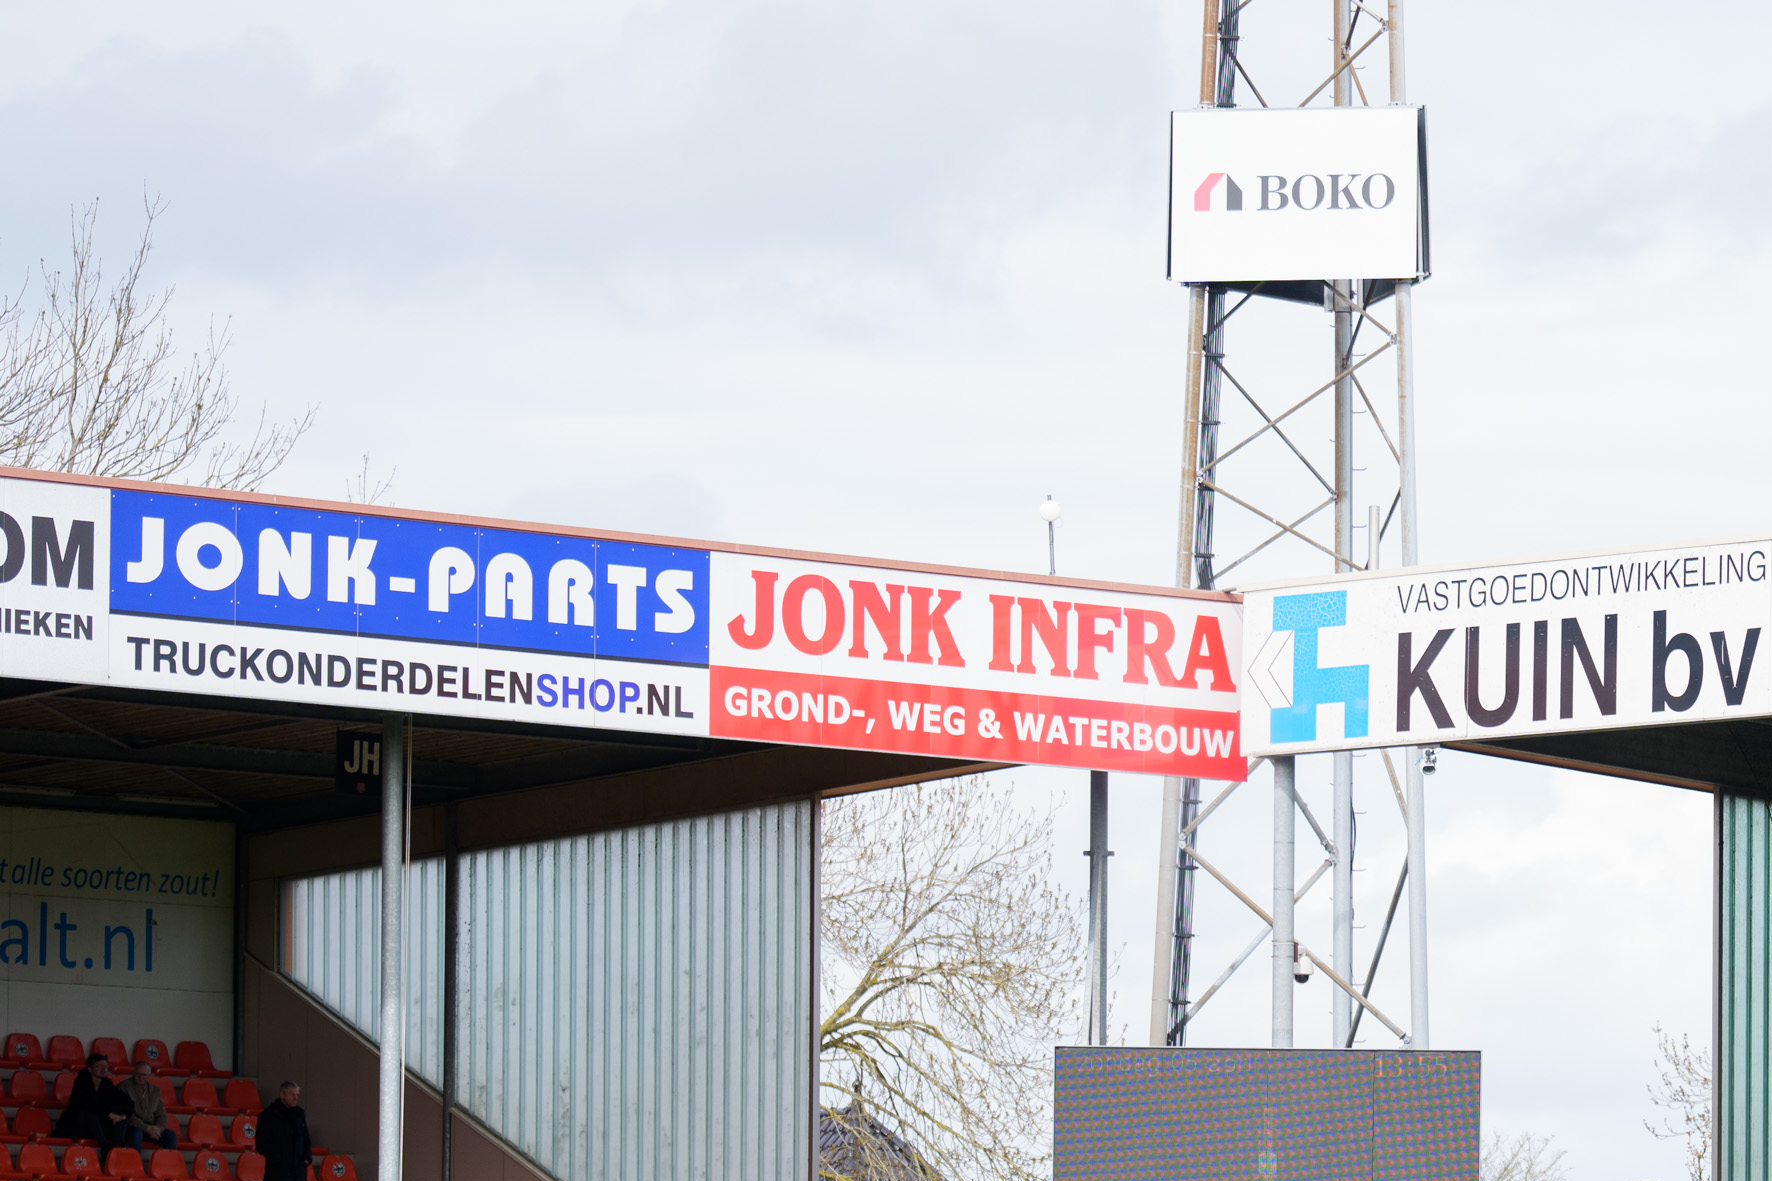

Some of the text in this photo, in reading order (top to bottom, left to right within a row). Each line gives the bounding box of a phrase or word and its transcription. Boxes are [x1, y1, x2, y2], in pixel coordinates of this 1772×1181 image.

[1256, 173, 1395, 211] BOKO
[127, 516, 696, 634] JONK-PARTS
[1397, 550, 1767, 615] VASTGOEDONTWIKKELING
[0, 607, 93, 641] IEKEN
[727, 569, 1238, 693] JONK INFRA
[126, 636, 694, 719] TRUCKONDERDELENSHOP.NL
[1396, 609, 1762, 733] KUIN bv
[343, 739, 380, 775] JH
[724, 685, 1235, 759] GROND-, WEG & WATERBOUW
[11, 857, 55, 888] alle
[61, 866, 151, 893] soorten
[158, 870, 219, 897] zout!
[1, 902, 154, 973] alt.nl
